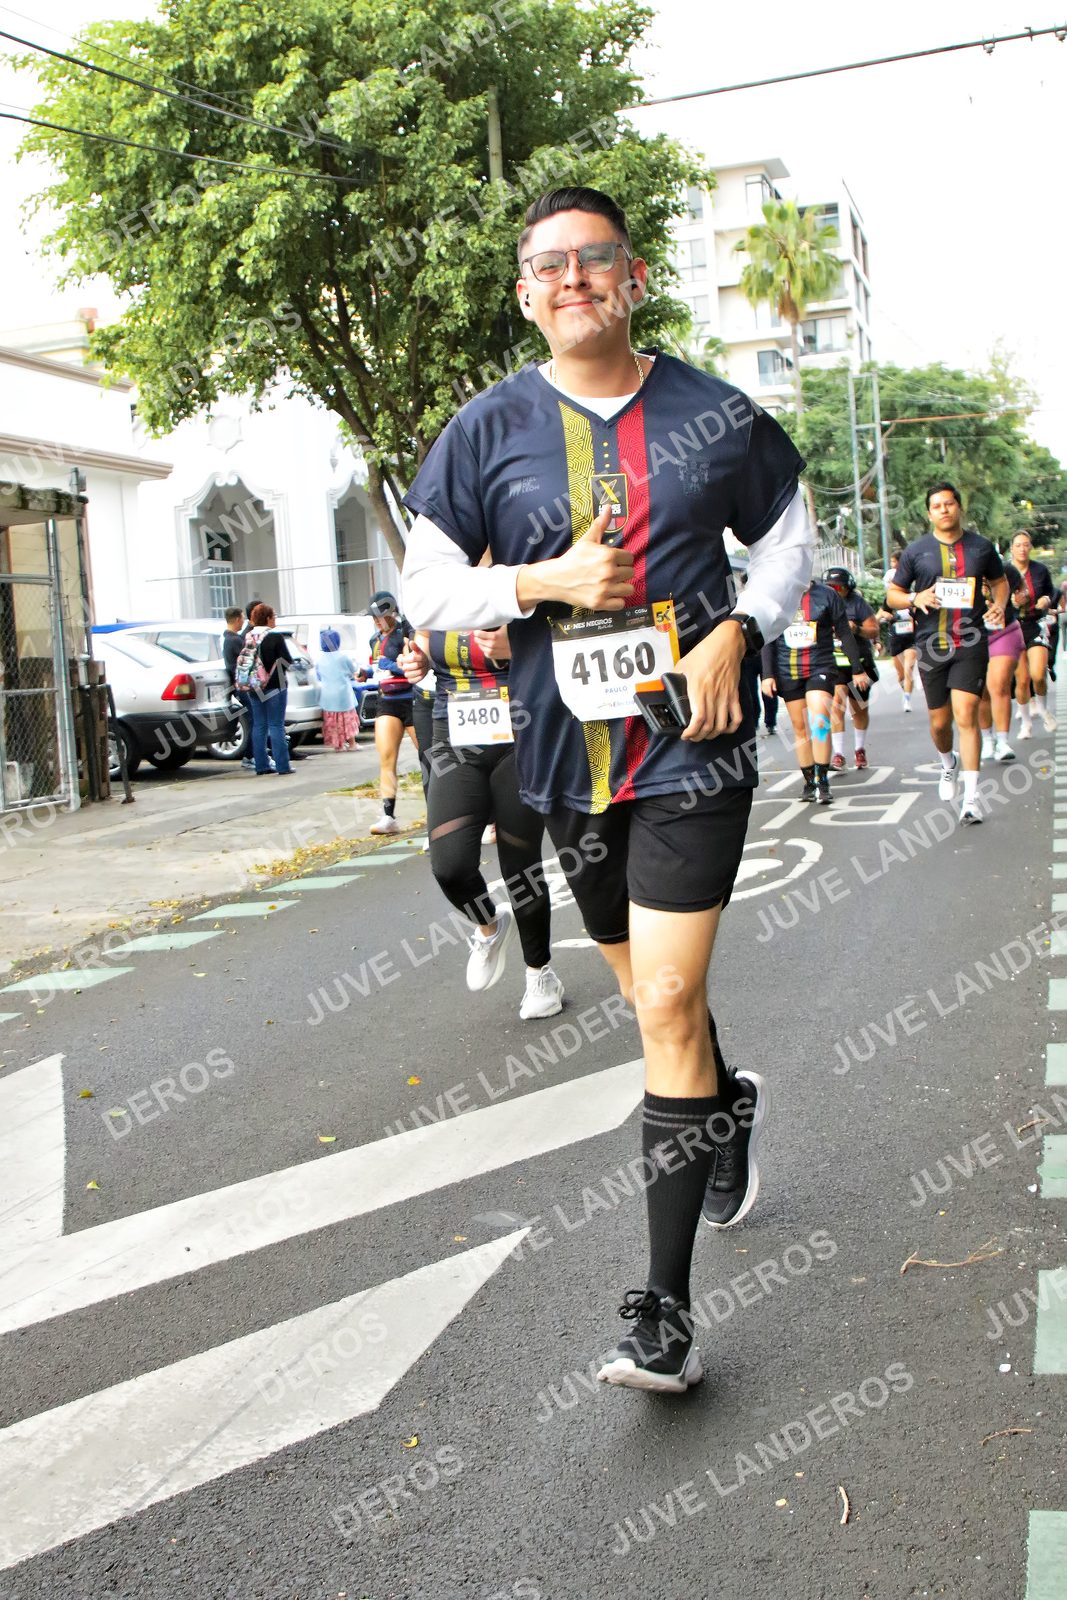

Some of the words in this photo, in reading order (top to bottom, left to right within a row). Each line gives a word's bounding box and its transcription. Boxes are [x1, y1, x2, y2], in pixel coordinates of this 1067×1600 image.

[571, 641, 656, 686] 4160
[604, 685, 628, 694] PAULO
[457, 706, 500, 727] 3480
